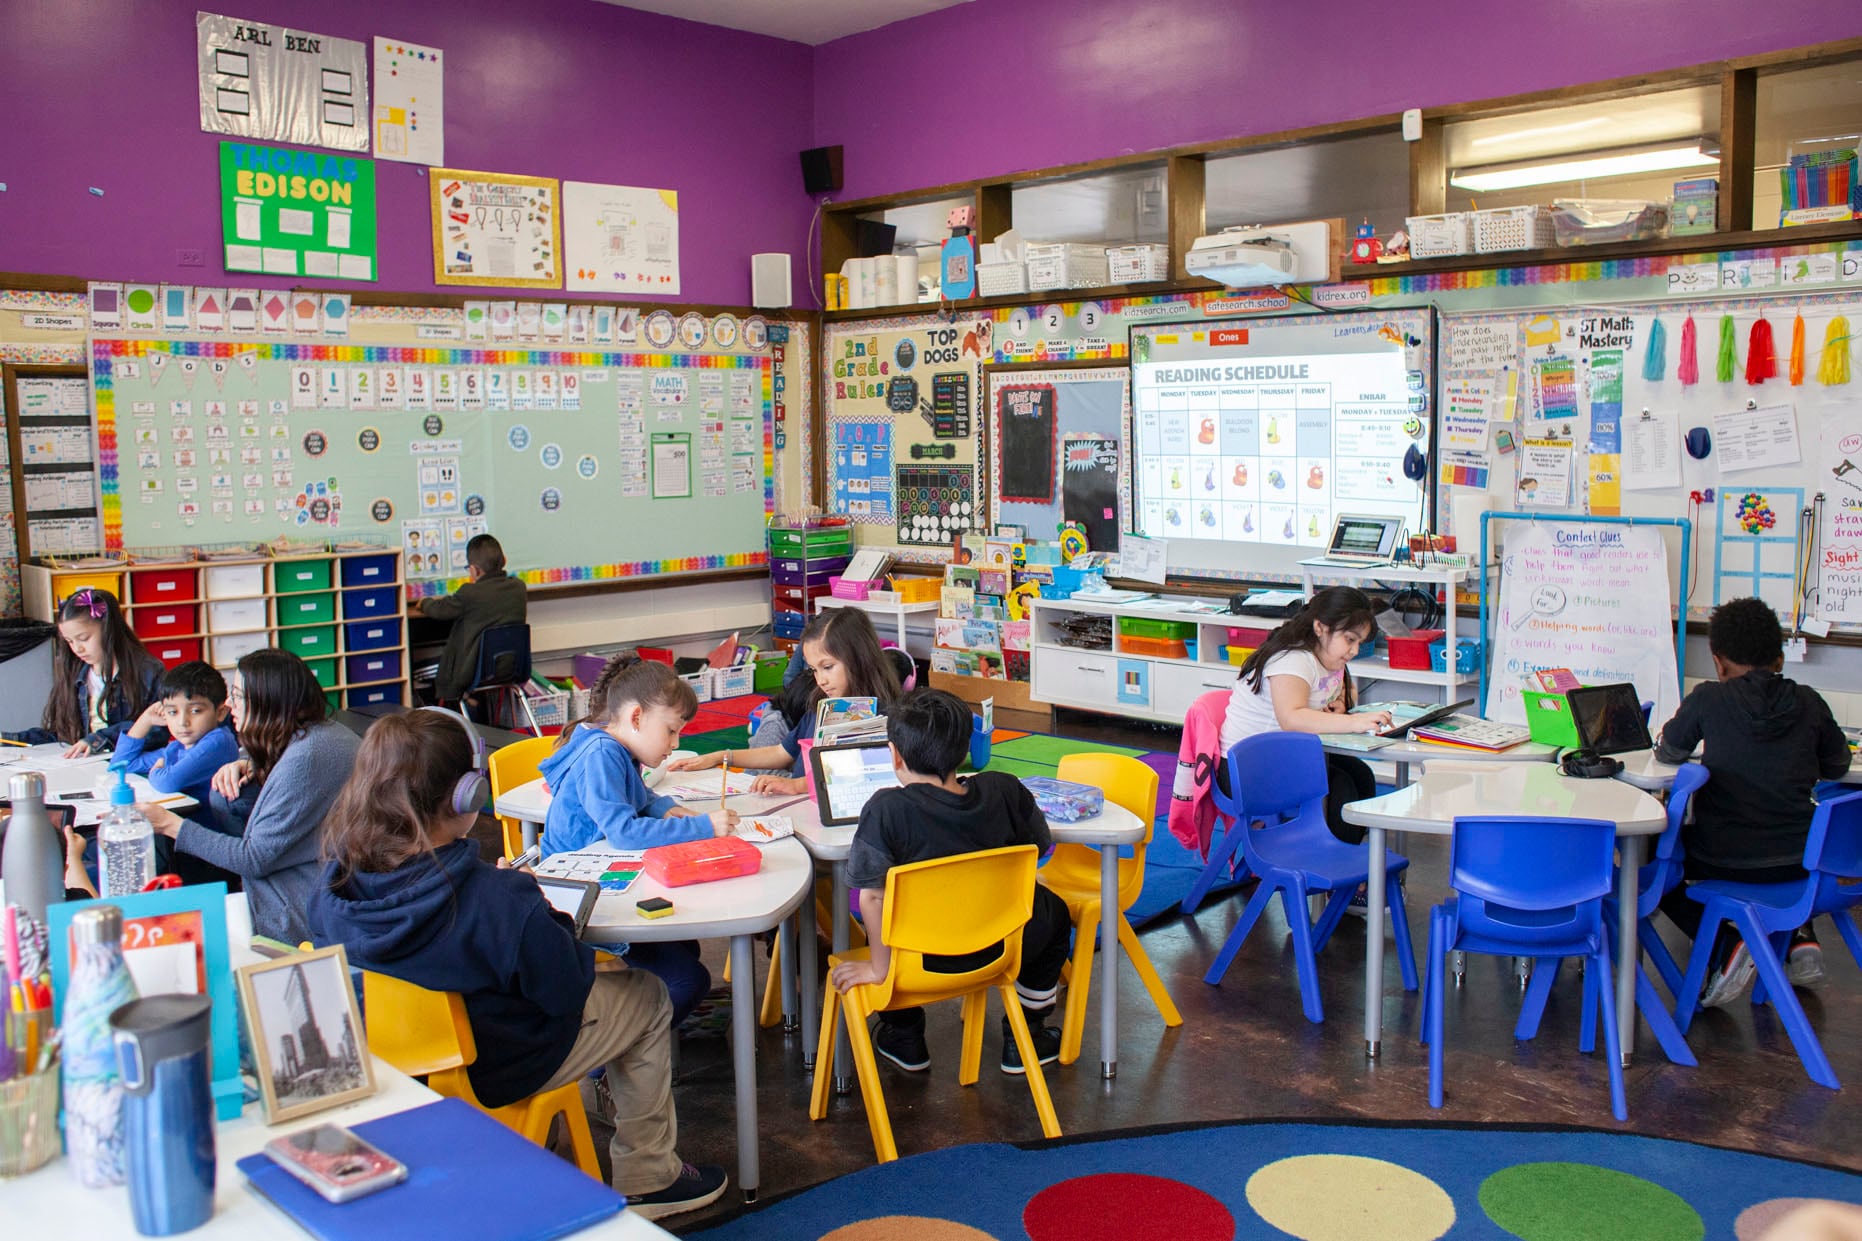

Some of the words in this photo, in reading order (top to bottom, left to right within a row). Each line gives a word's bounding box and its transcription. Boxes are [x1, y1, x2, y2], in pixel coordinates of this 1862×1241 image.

[286, 35, 320, 54] BEN
[230, 144, 358, 182] THOMAS
[237, 170, 352, 205] EDISON
[1843, 259, 1858, 276] D
[1668, 274, 1680, 288] P
[1723, 270, 1736, 284] R
[1316, 290, 1368, 303] kidrex.org
[1124, 304, 1187, 318] kidzsearch.com
[1207, 296, 1288, 312] safesearch.school
[1017, 320, 1022, 330] 1
[1050, 316, 1057, 326] 2
[1087, 313, 1094, 324] 3
[1581, 318, 1596, 332] ST
[1600, 316, 1634, 331] Math
[927, 328, 957, 347] TOP
[1218, 333, 1239, 342] Ones
[1474, 326, 1491, 335] does
[845, 337, 878, 358] 2nd
[1580, 333, 1632, 350] Mastery
[924, 348, 959, 364] DOGS
[834, 357, 888, 378] Grade
[1155, 368, 1221, 384] READING
[1224, 364, 1309, 381] SCHEDULE
[1531, 366, 1538, 375] 0
[300, 371, 310, 386] 0
[358, 372, 368, 387] 2
[386, 373, 395, 387] 3
[413, 373, 423, 388] 4
[440, 374, 449, 388] 5
[467, 375, 476, 388] 6
[492, 375, 500, 387] 7
[518, 375, 526, 388] 8
[542, 375, 551, 388] 9
[564, 375, 576, 389] 10
[655, 376, 682, 388] MATH
[1532, 388, 1539, 398] 2
[1533, 399, 1540, 409] 3
[1452, 416, 1487, 424] Wednesday
[1454, 426, 1483, 434] Thursday
[922, 447, 943, 455] MARCH
[1556, 528, 1596, 544] Context
[1600, 528, 1622, 543] Clues
[1826, 551, 1859, 566] Sight
[1525, 560, 1545, 572] help
[1826, 601, 1844, 612] old
[1541, 622, 1579, 634] Helping
